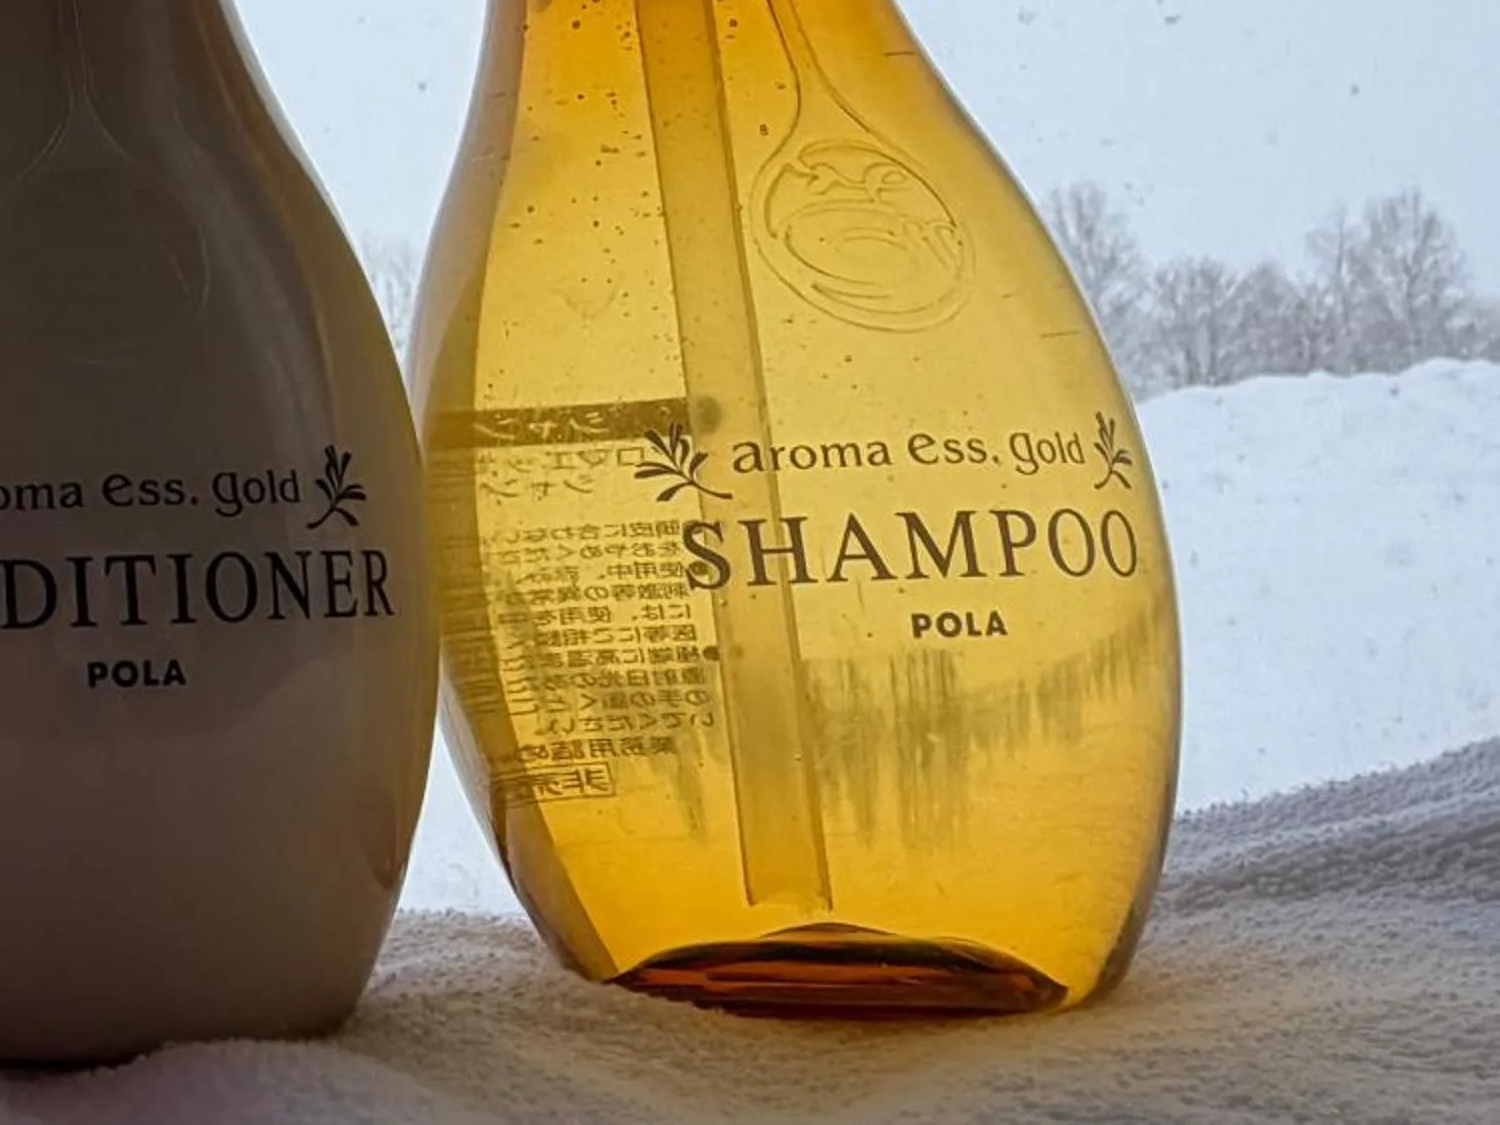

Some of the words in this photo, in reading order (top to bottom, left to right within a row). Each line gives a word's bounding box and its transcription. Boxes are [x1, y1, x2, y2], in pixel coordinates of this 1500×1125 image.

[732, 439, 893, 475] aroma
[908, 432, 1000, 466] ess.
[1009, 431, 1086, 475] gold
[102, 471, 199, 509] ess.
[212, 468, 301, 518] gold
[681, 507, 1138, 592] SHAMPOO
[911, 610, 1009, 638] POLA
[87, 659, 187, 689] POLA
